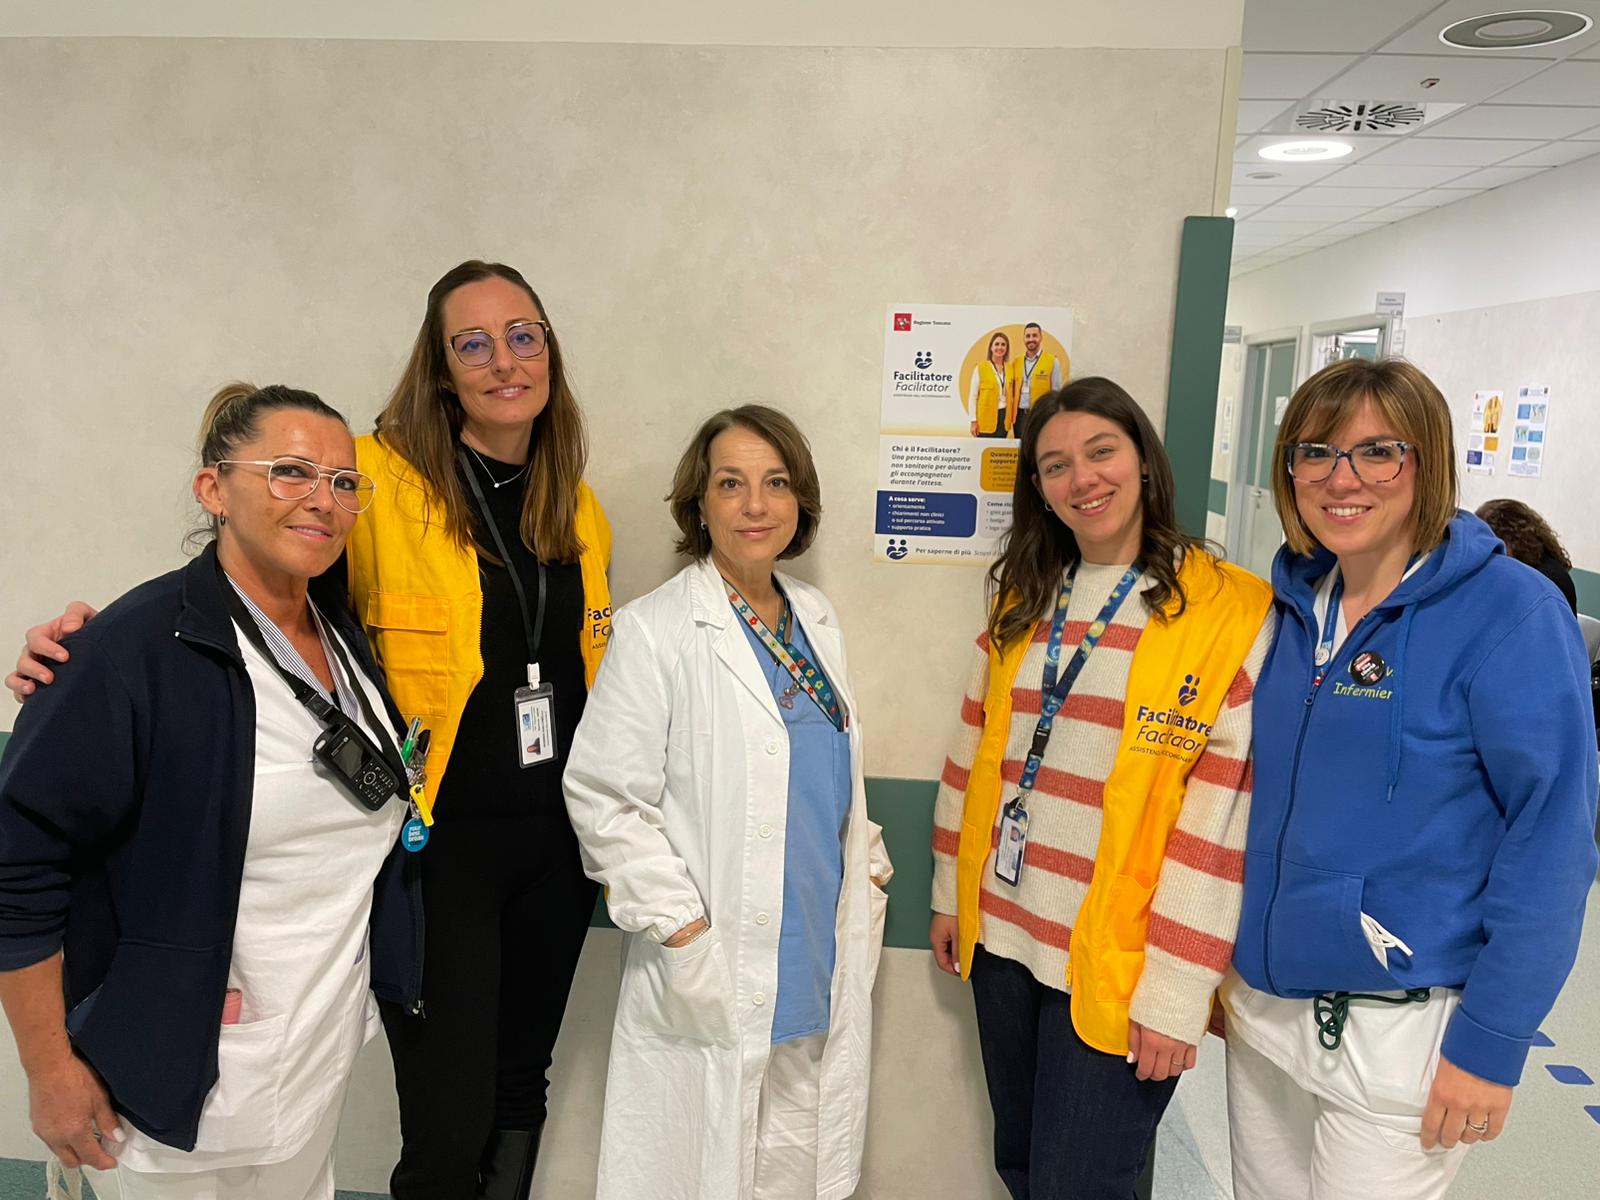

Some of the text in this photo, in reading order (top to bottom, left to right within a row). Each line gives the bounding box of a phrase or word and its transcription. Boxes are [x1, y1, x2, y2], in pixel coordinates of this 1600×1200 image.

[893, 371, 953, 382] Facilitatore
[895, 381, 949, 392] Facilitator
[900, 471, 952, 479] accompagnatori
